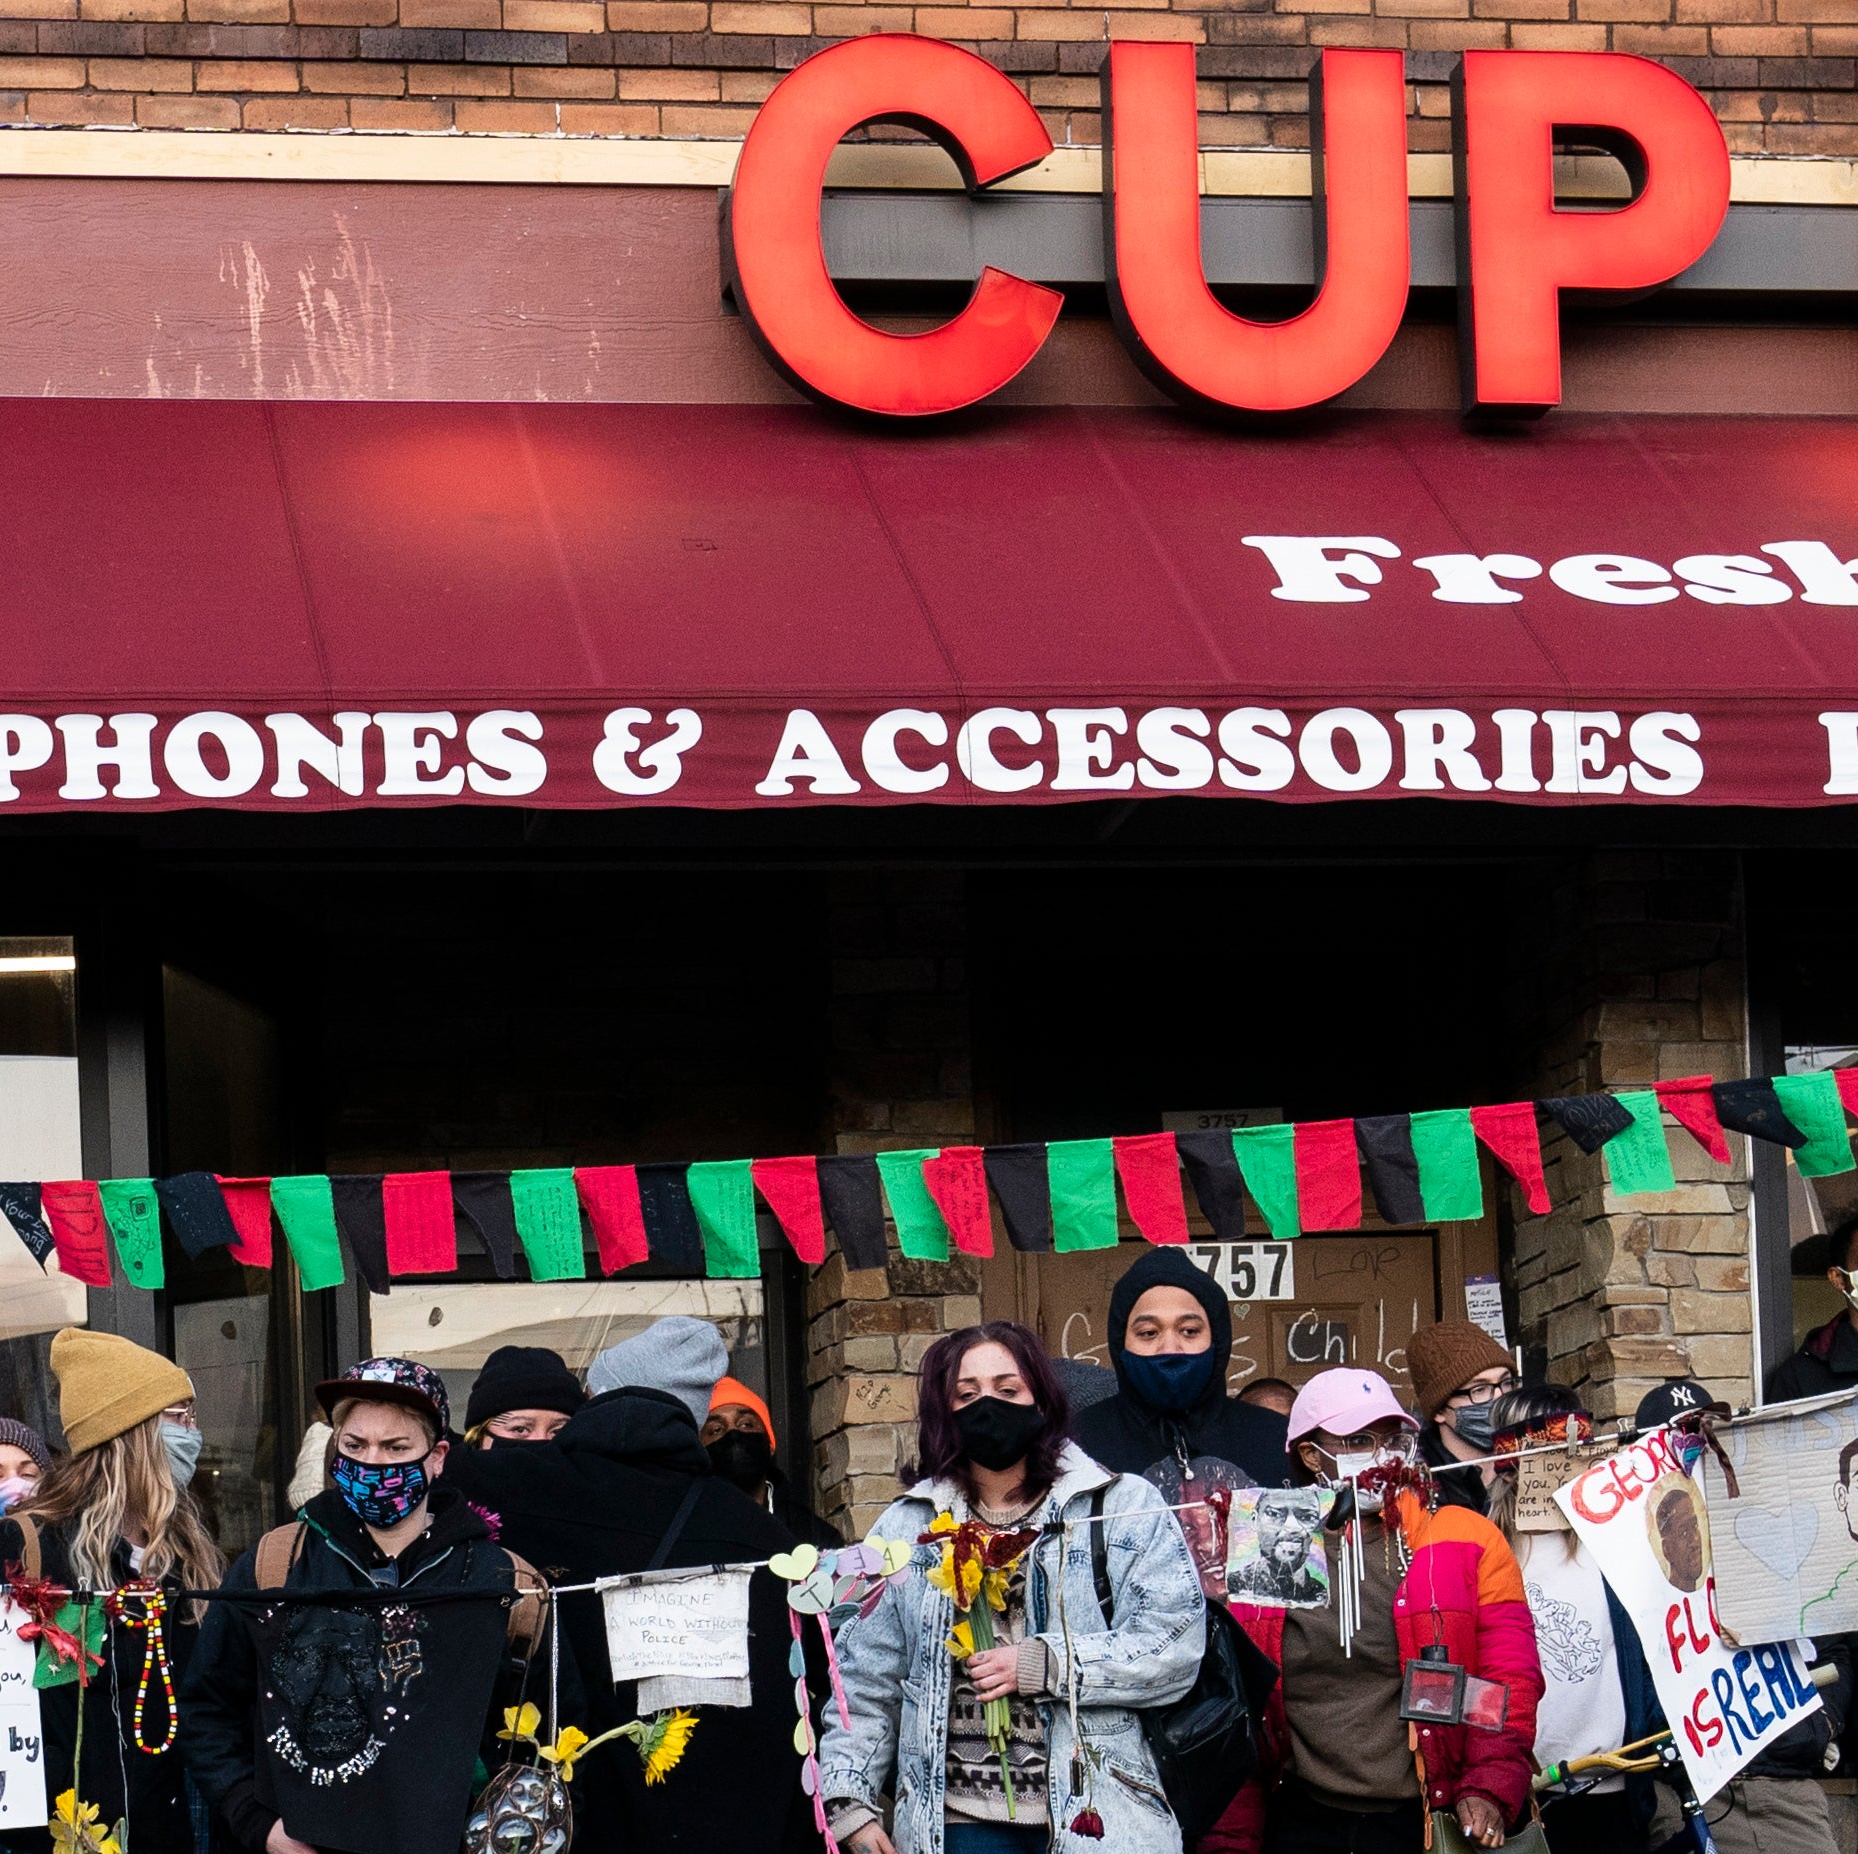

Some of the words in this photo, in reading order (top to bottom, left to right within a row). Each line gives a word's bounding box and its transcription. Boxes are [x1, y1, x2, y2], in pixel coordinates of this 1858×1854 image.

[728, 34, 1733, 417] CUP
[593, 707, 703, 796] &
[755, 706, 1704, 796] ACCESSORIES
[1189, 1243, 1289, 1299] 757
[1523, 1459, 1536, 1475] I
[1543, 1459, 1573, 1473] love
[1518, 1496, 1537, 1505] are
[1523, 1479, 1551, 1496] you.
[629, 1615, 676, 1630] WORLD
[641, 1630, 688, 1645] POLICE
[1684, 1687, 1724, 1758] IS
[1712, 1640, 1817, 1757] REAL
[9, 1726, 41, 1763] by
